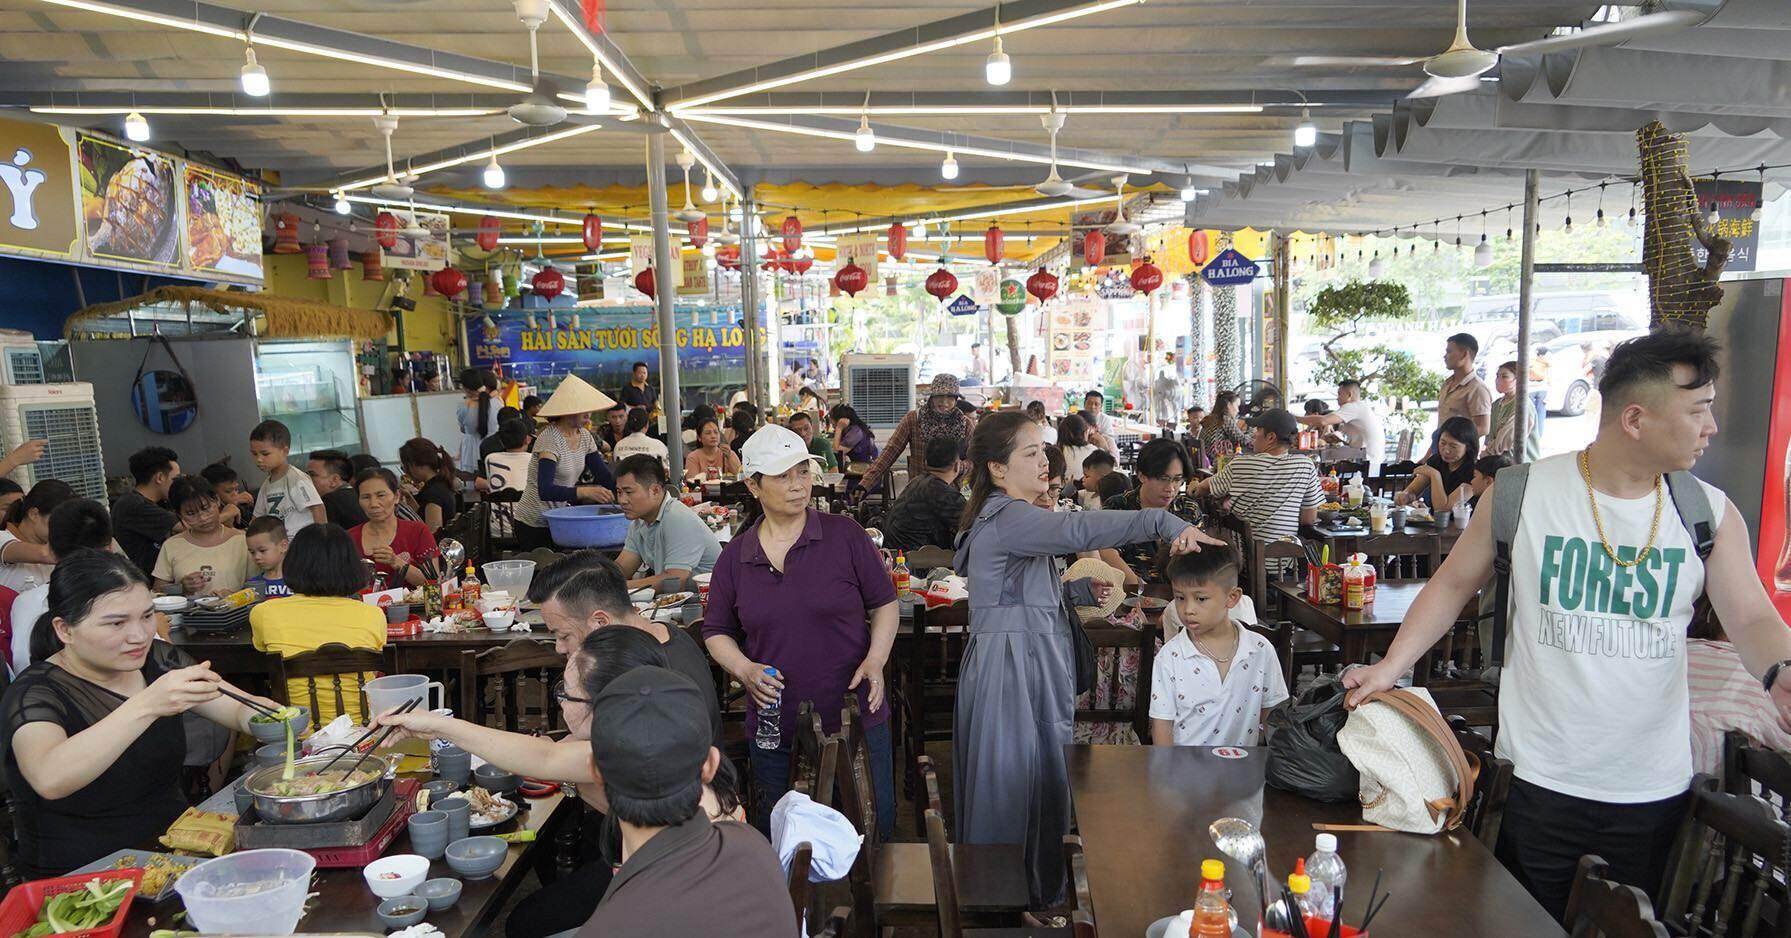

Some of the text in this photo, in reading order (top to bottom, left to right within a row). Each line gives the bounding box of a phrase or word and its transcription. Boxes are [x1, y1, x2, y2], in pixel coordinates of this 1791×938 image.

[1222, 259, 1239, 268] BIA
[521, 323, 553, 351] HẢI
[557, 322, 592, 350] SẢN
[641, 321, 688, 349] SỐG
[692, 327, 718, 352] HẠ
[1540, 535, 1686, 620] FOREST
